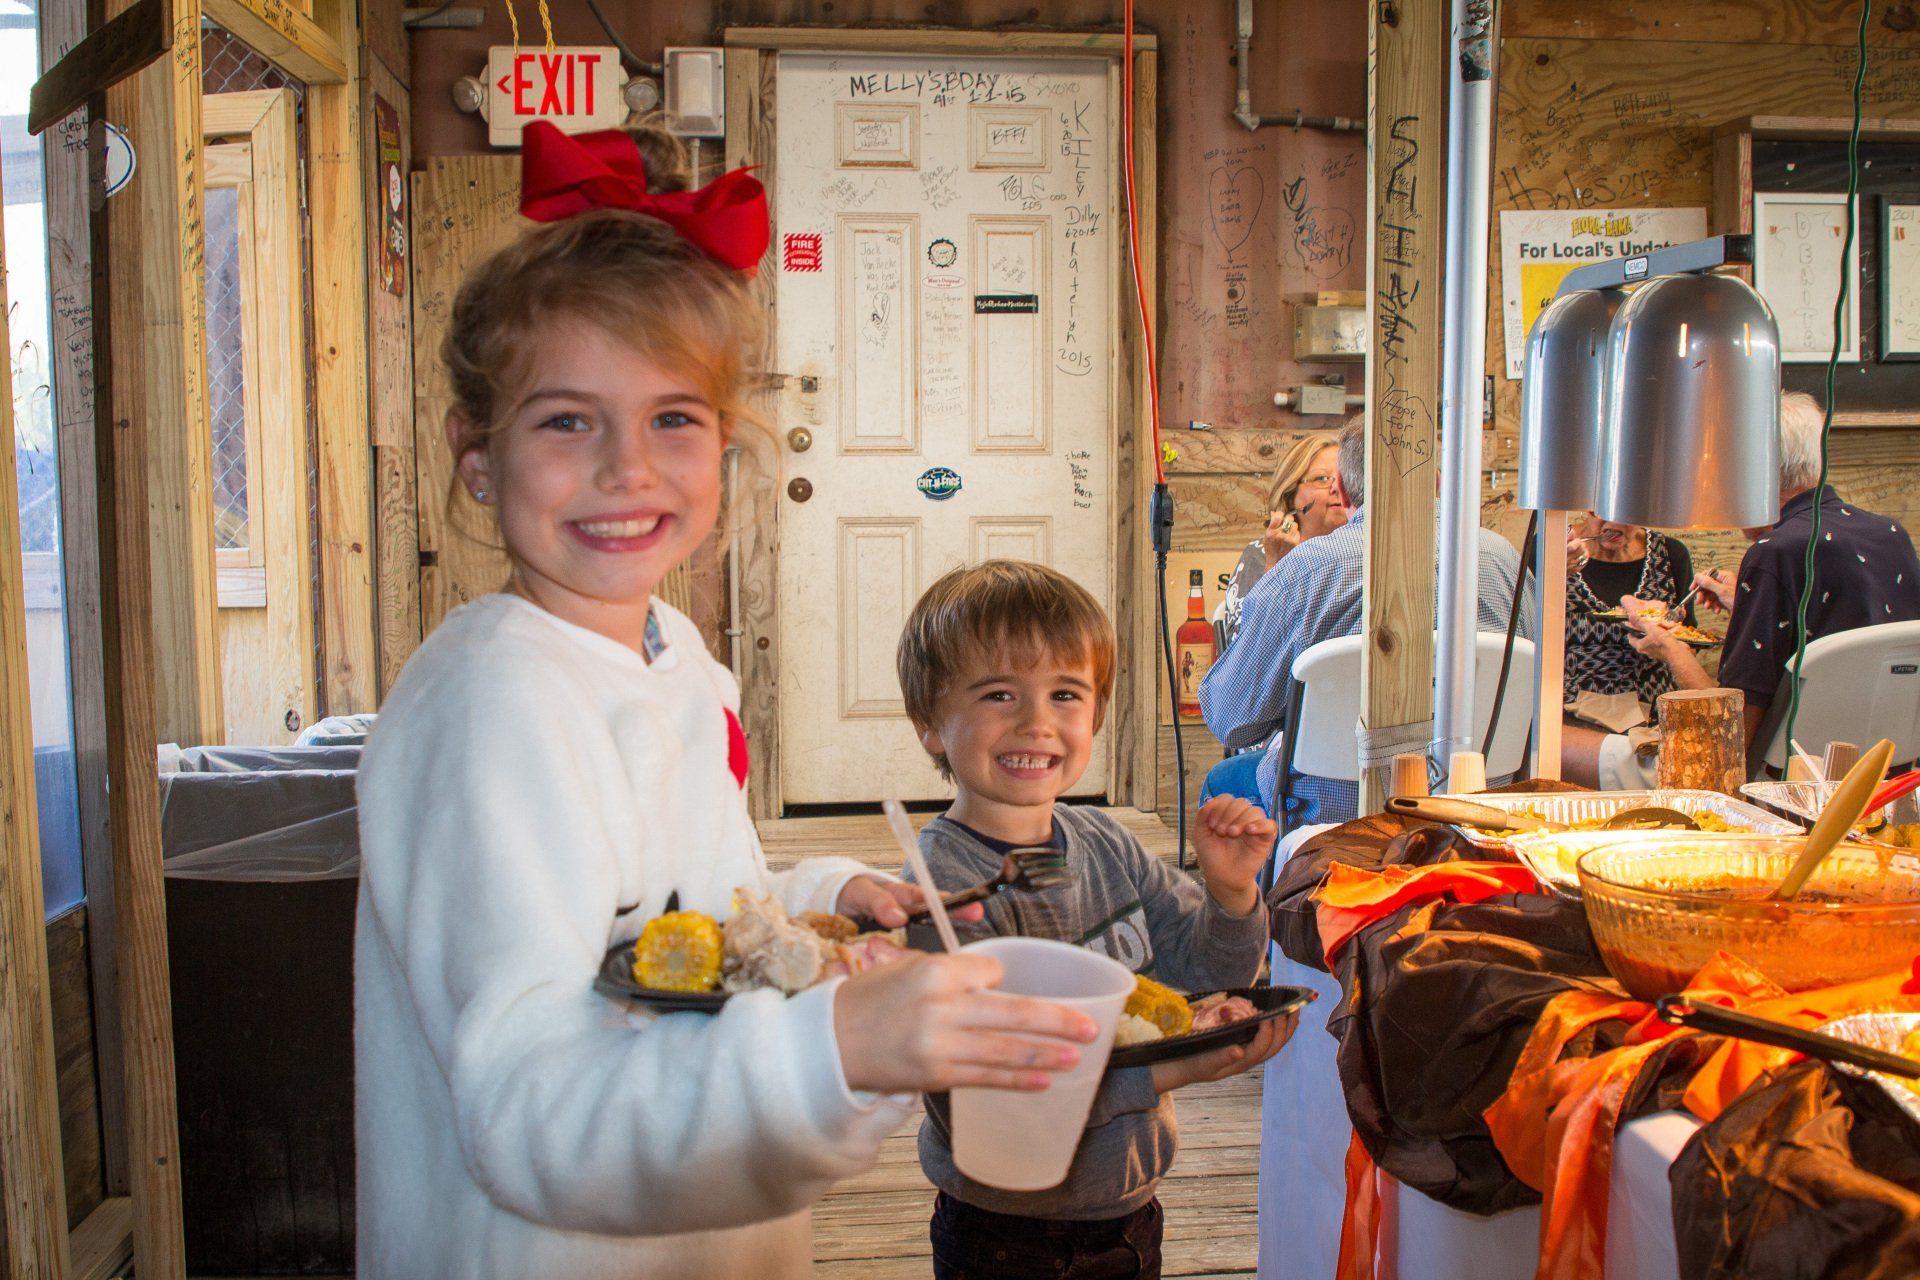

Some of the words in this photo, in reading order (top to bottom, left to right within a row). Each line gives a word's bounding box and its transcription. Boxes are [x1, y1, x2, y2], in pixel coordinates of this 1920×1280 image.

[514, 54, 601, 116] EXIT
[791, 240, 815, 249] FIRE
[1520, 243, 1547, 258] For
[1553, 241, 1614, 258] Local's
